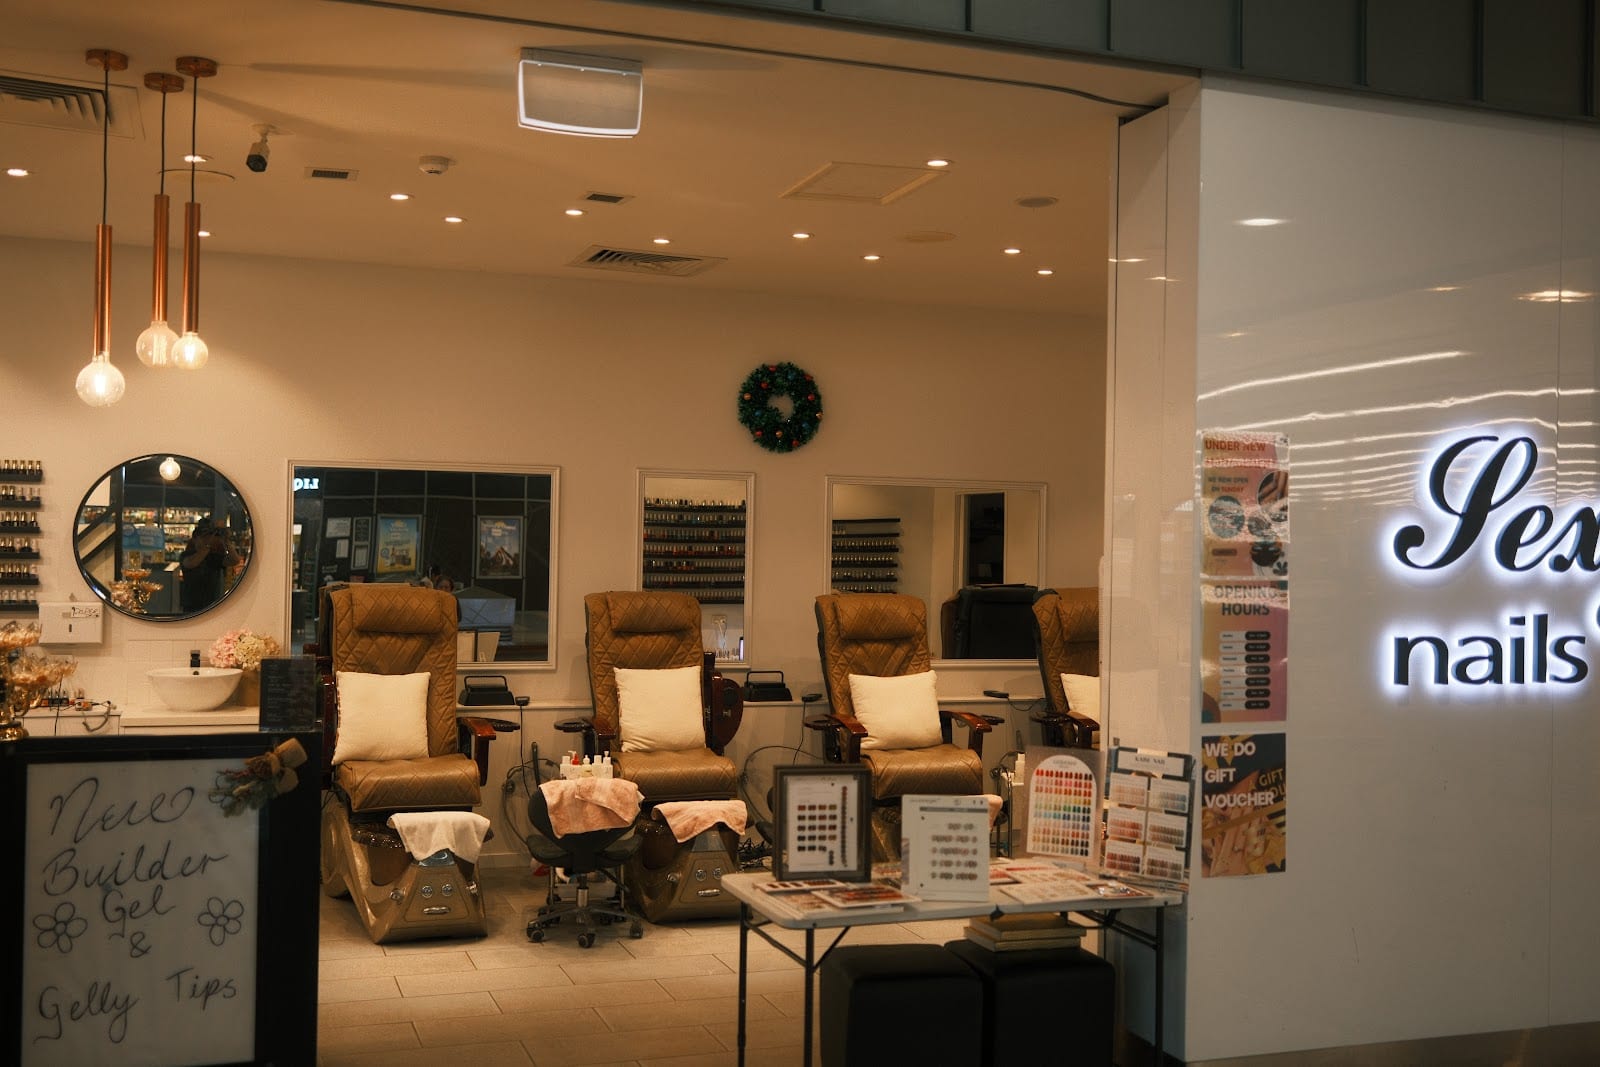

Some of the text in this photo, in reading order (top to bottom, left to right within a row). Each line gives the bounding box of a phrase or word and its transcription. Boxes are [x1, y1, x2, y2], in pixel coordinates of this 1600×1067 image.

[1205, 440, 1266, 452] UNDER NEW
[1214, 585, 1278, 599] OPENING
[1222, 602, 1270, 616] HOURS
[1394, 613, 1588, 685] nails
[1204, 742, 1256, 757] WE DO
[1204, 768, 1236, 783] GIFT
[1259, 768, 1283, 786] GIFT
[1204, 791, 1275, 809] VOUCHER
[43, 840, 229, 896] Builder
[102, 884, 176, 939] Gel
[130, 931, 151, 958] &
[33, 967, 238, 1043] Gelly Tips
